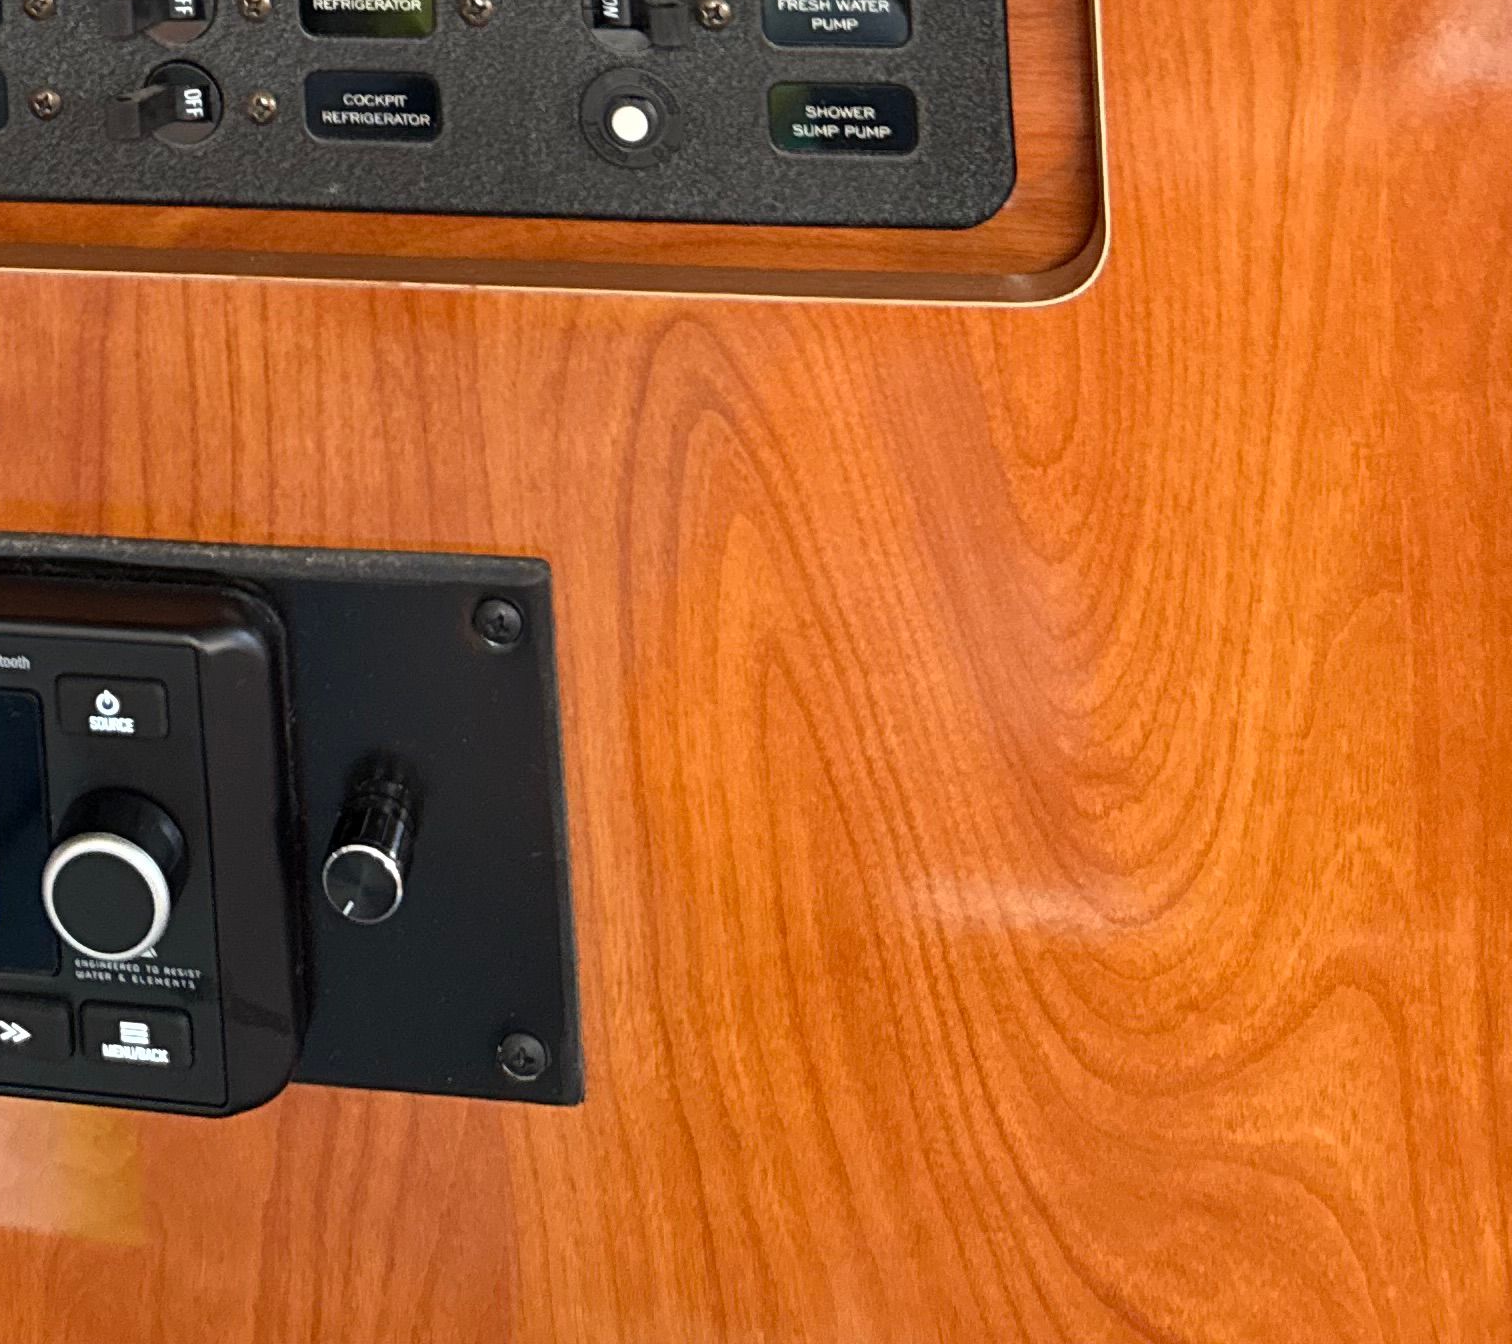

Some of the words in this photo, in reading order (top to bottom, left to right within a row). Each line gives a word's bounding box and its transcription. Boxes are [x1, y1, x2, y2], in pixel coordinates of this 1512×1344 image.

[835, 0, 890, 12] WATER
[811, 18, 859, 31] PUMP
[343, 94, 408, 107] COCKPIT
[322, 112, 431, 126] REFRIGERATOR
[805, 106, 875, 120] SHOWER
[89, 716, 134, 734] SOURCE
